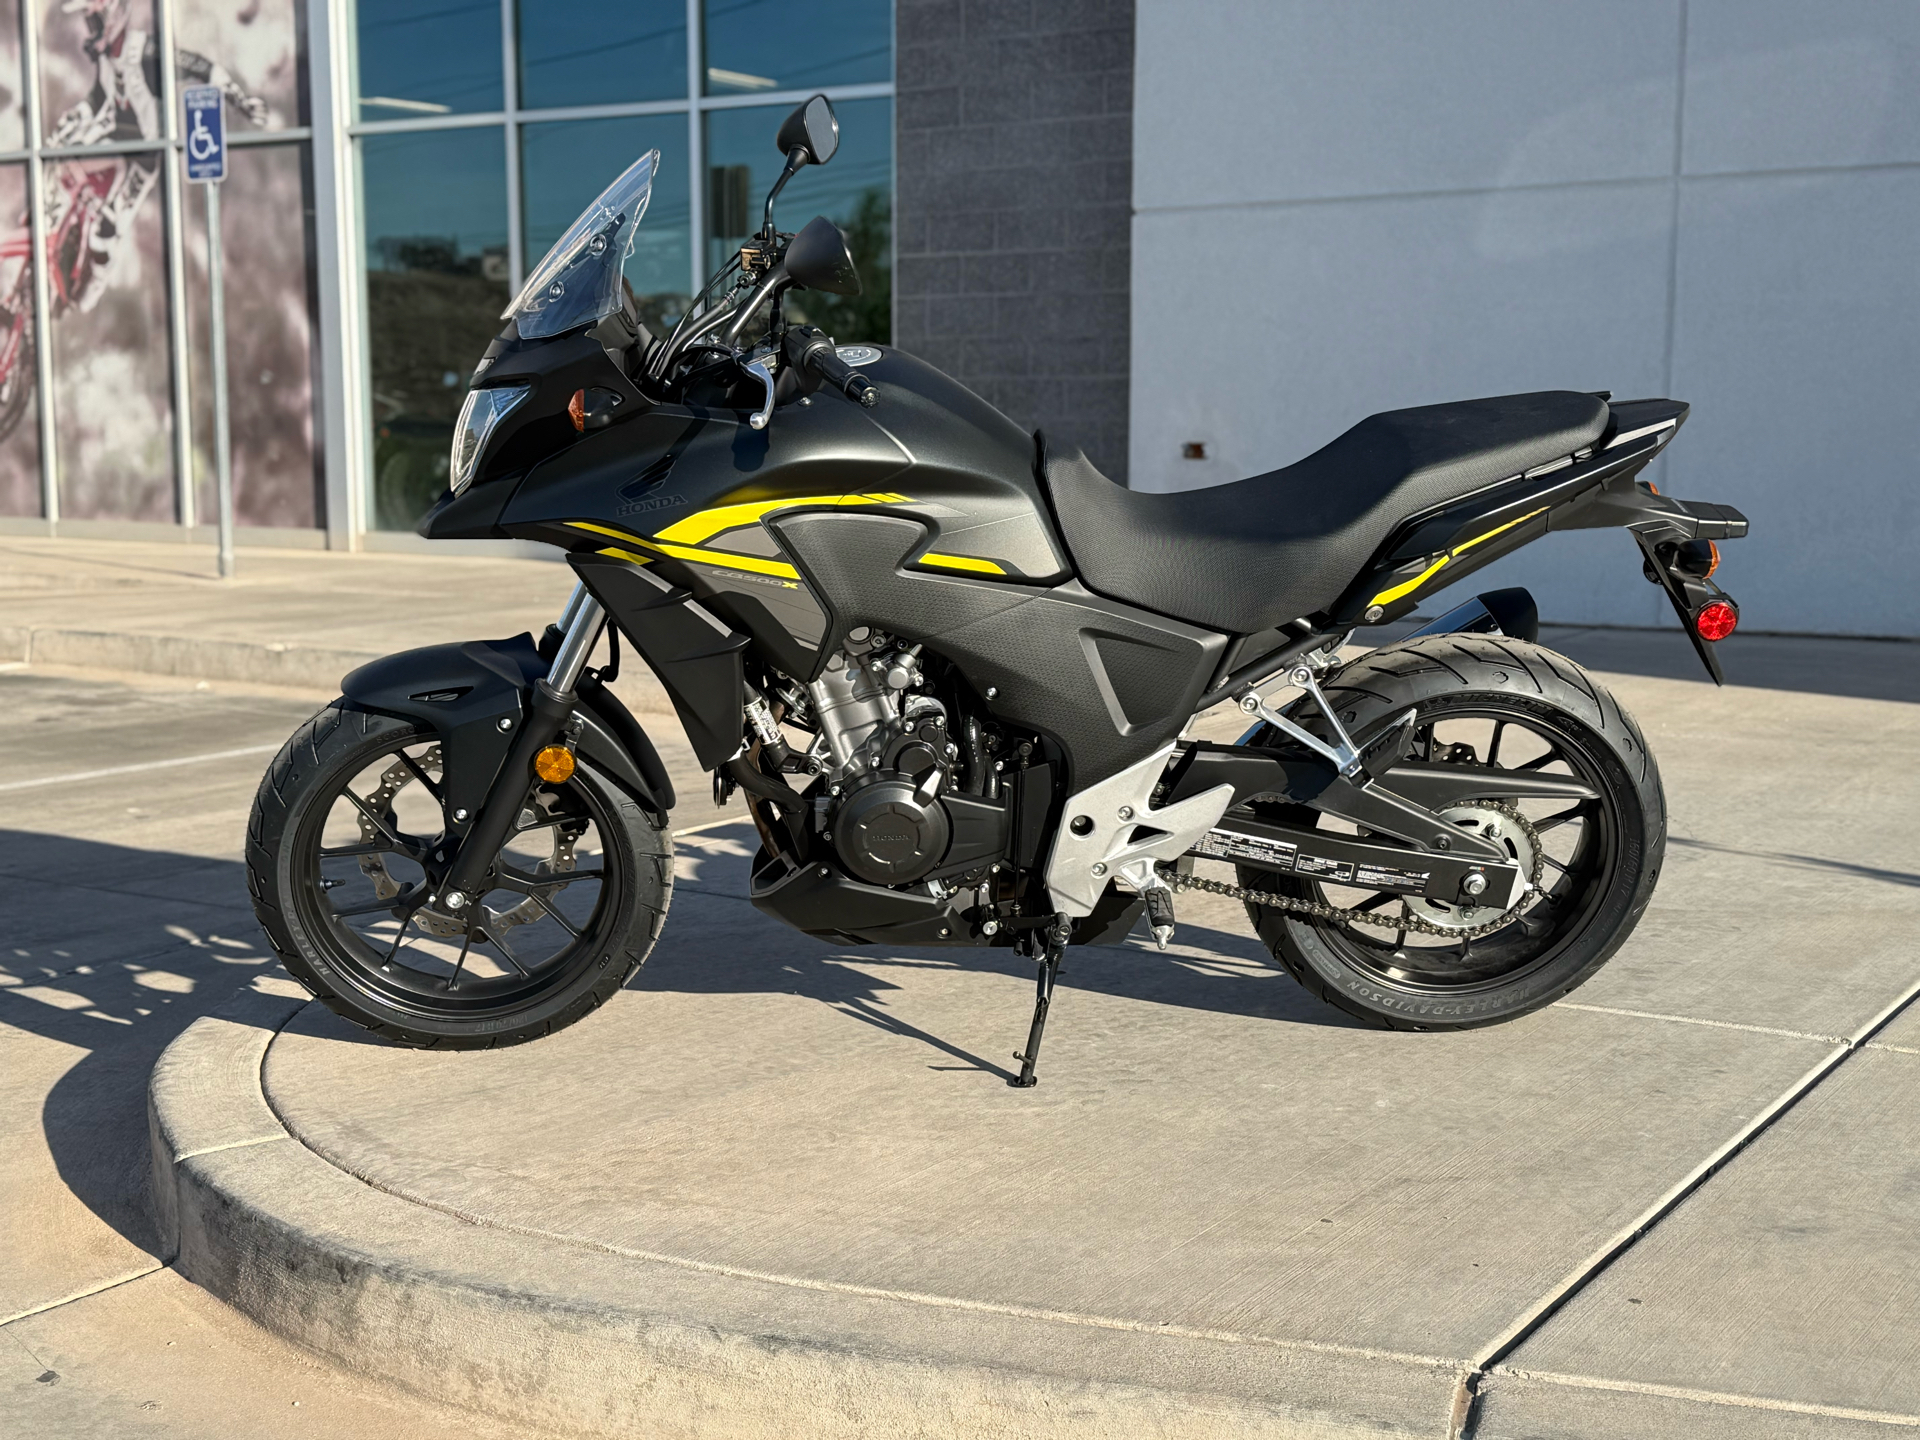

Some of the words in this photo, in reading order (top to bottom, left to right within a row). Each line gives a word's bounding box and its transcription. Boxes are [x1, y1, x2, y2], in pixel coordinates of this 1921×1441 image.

[616, 493, 688, 517] HONDA
[712, 570, 798, 590] CB500X
[1451, 693, 1554, 718] MICHELIN
[376, 725, 418, 744] SCORC
[872, 834, 911, 842] HONDA
[1346, 980, 1529, 1015] HARLEY-DAVIDSON
